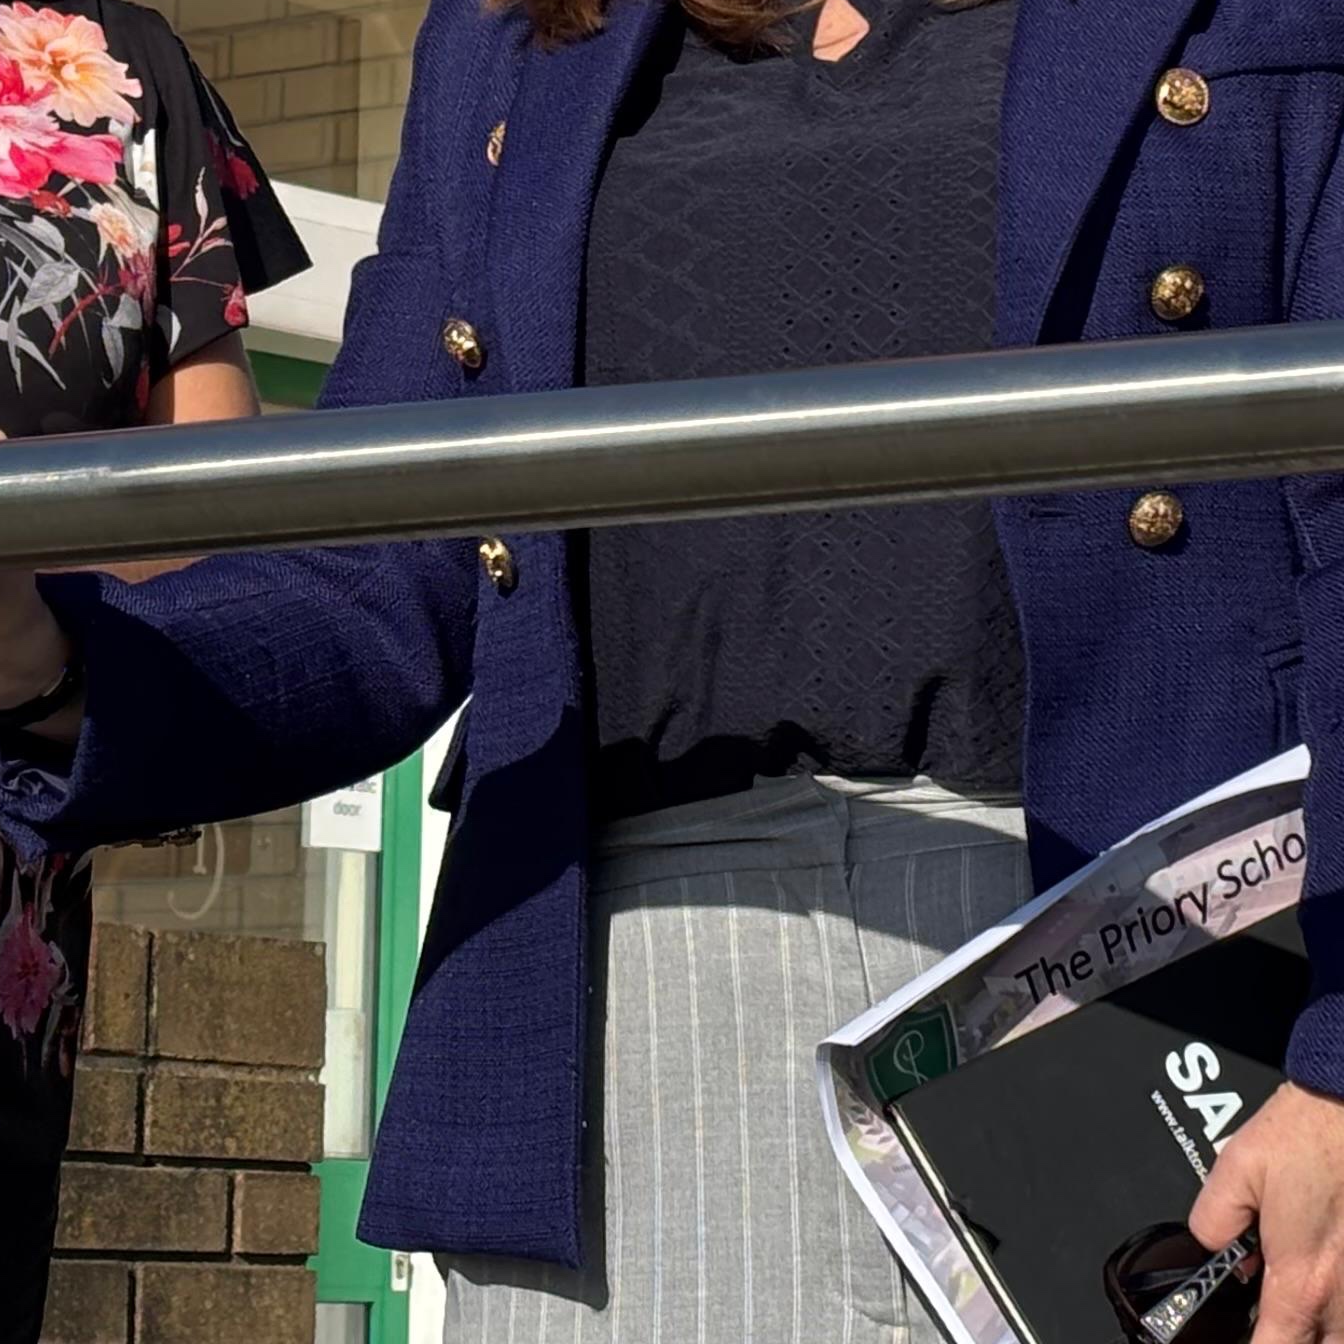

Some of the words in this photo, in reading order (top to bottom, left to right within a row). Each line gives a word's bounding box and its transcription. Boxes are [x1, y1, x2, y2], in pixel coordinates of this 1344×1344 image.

[1014, 950, 1094, 1005] The
[1099, 881, 1209, 965] Priory
[1217, 832, 1305, 901] Scho
[1165, 1041, 1243, 1156] SA
